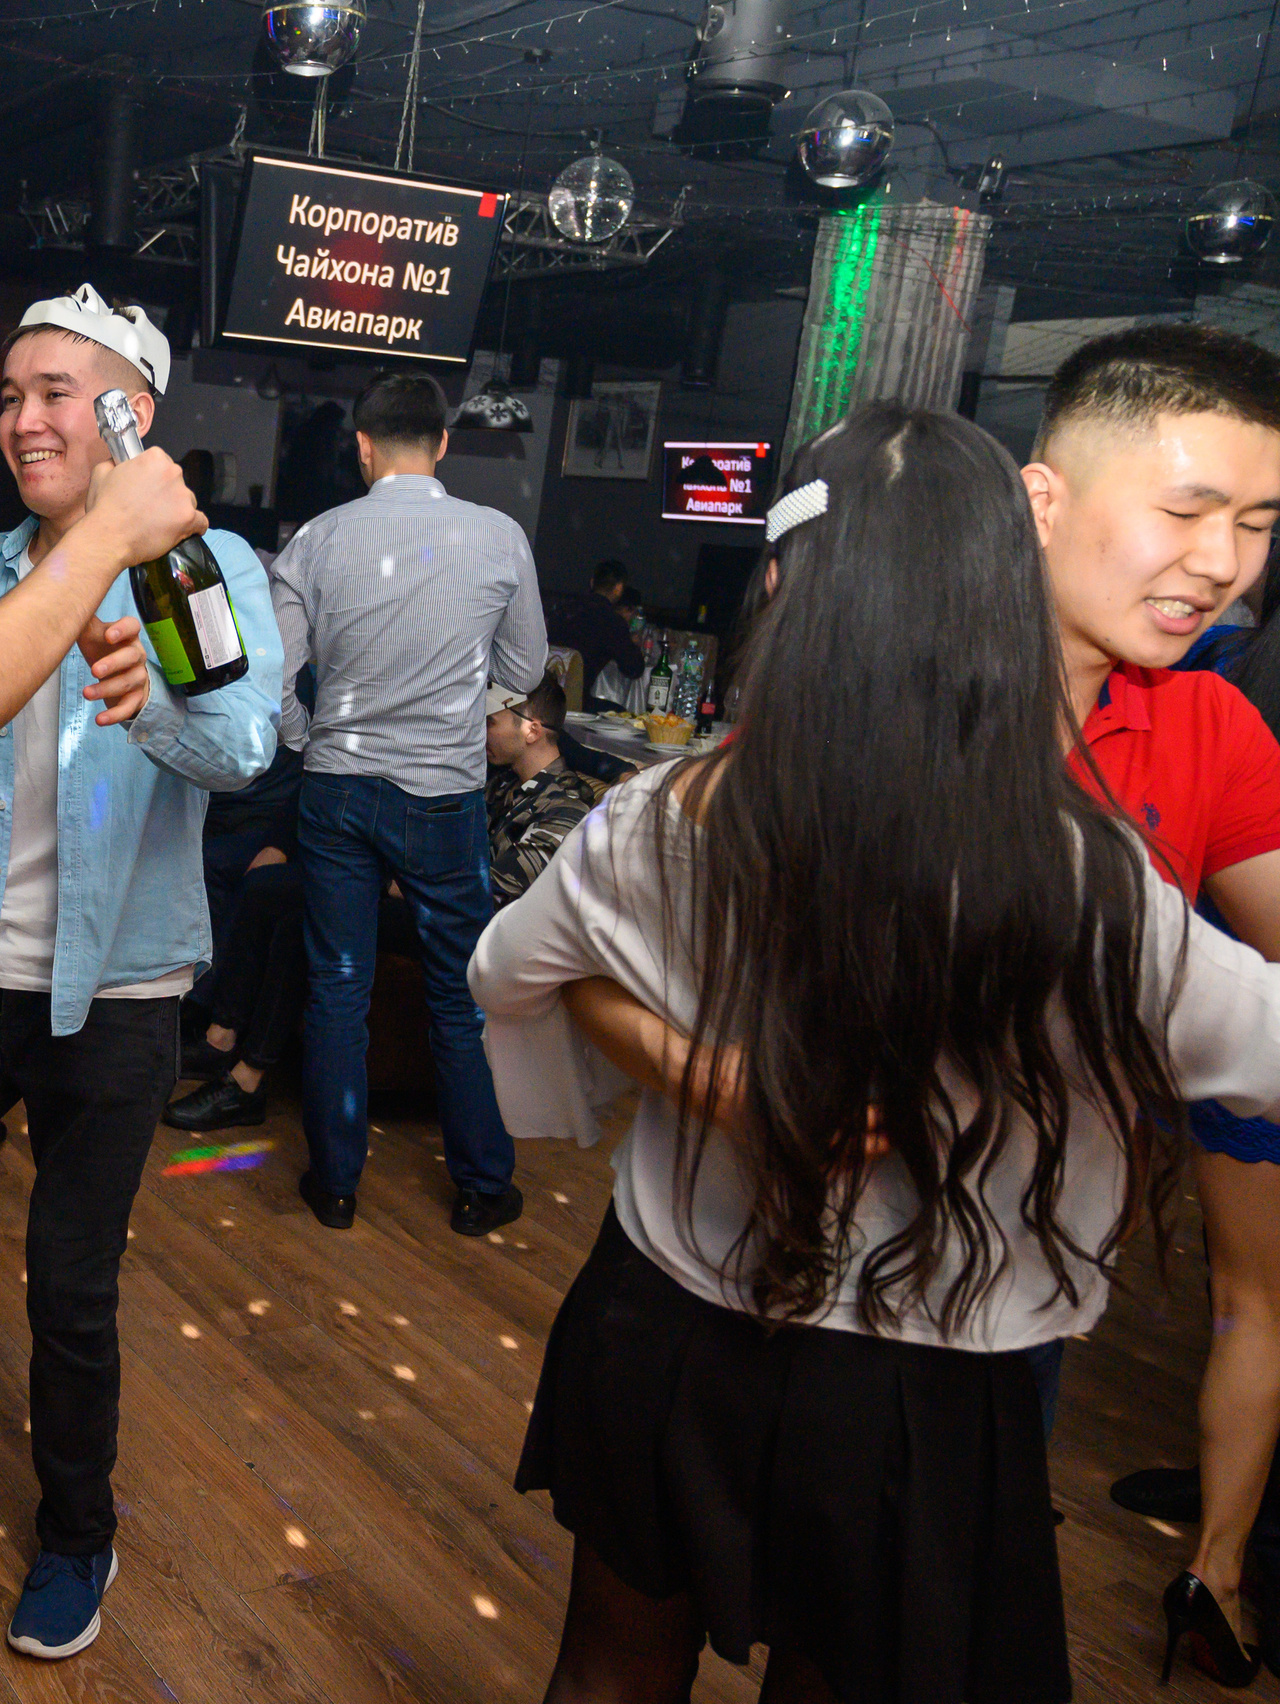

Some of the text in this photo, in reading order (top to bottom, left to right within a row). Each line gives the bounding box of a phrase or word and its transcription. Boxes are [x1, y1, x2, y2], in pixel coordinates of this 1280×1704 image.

[289, 194, 459, 246] Корпоратив
[276, 244, 451, 295] Чайхона №1
[284, 297, 423, 344] Авиапарк
[686, 497, 743, 516] Авиапарк
